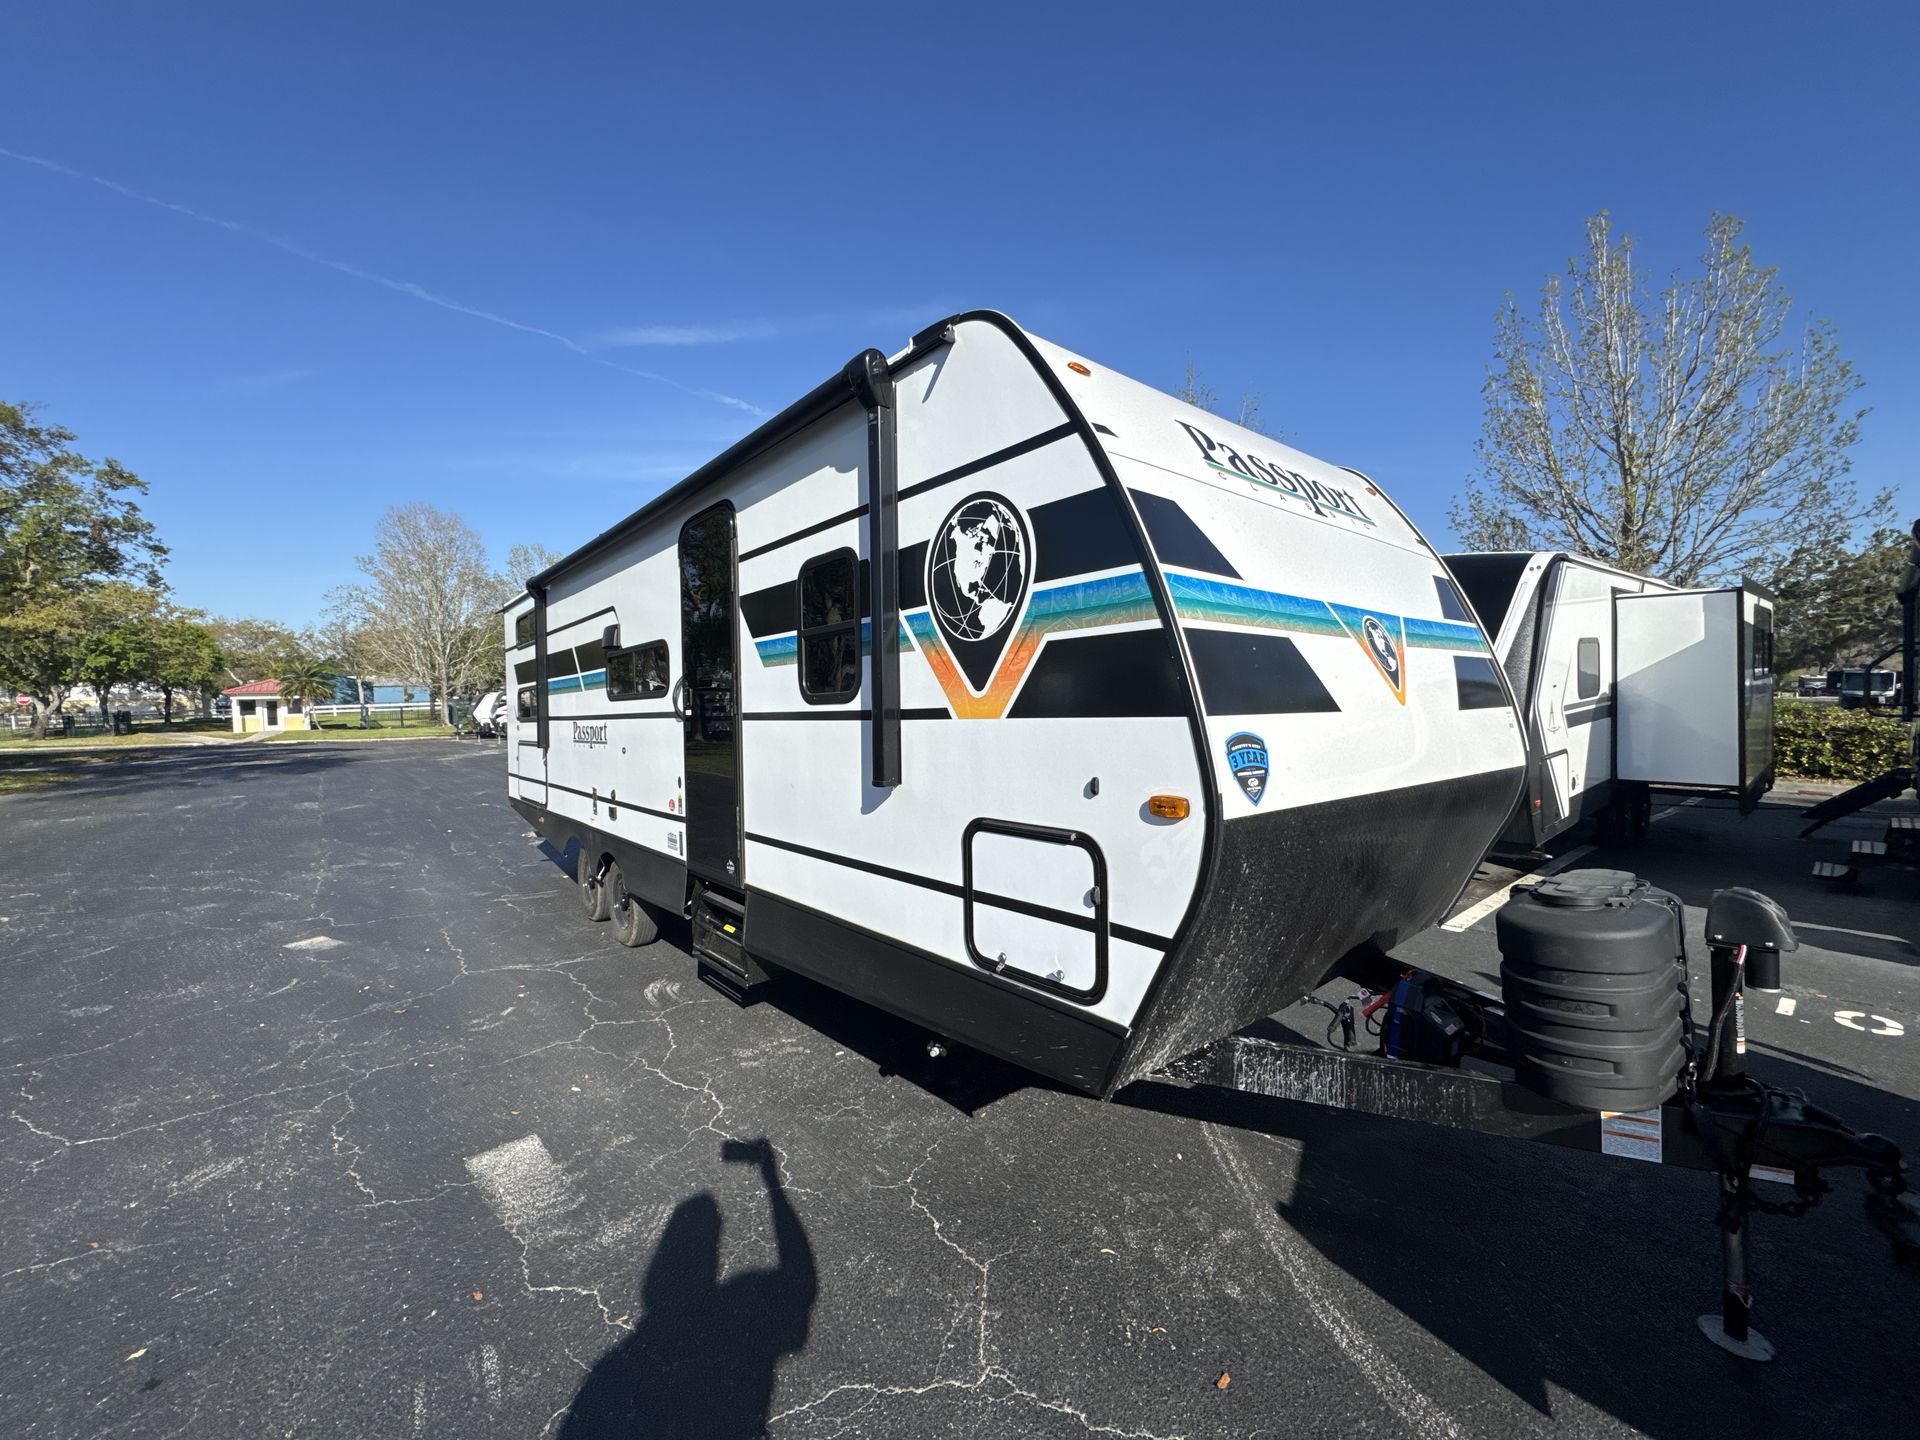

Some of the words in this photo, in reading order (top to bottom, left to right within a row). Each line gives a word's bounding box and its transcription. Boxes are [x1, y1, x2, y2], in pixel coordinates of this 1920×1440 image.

[1174, 419, 1371, 518] Passport
[573, 721, 608, 749] Passport
[1231, 755, 1239, 769] 3
[1239, 750, 1266, 766] YEAR
